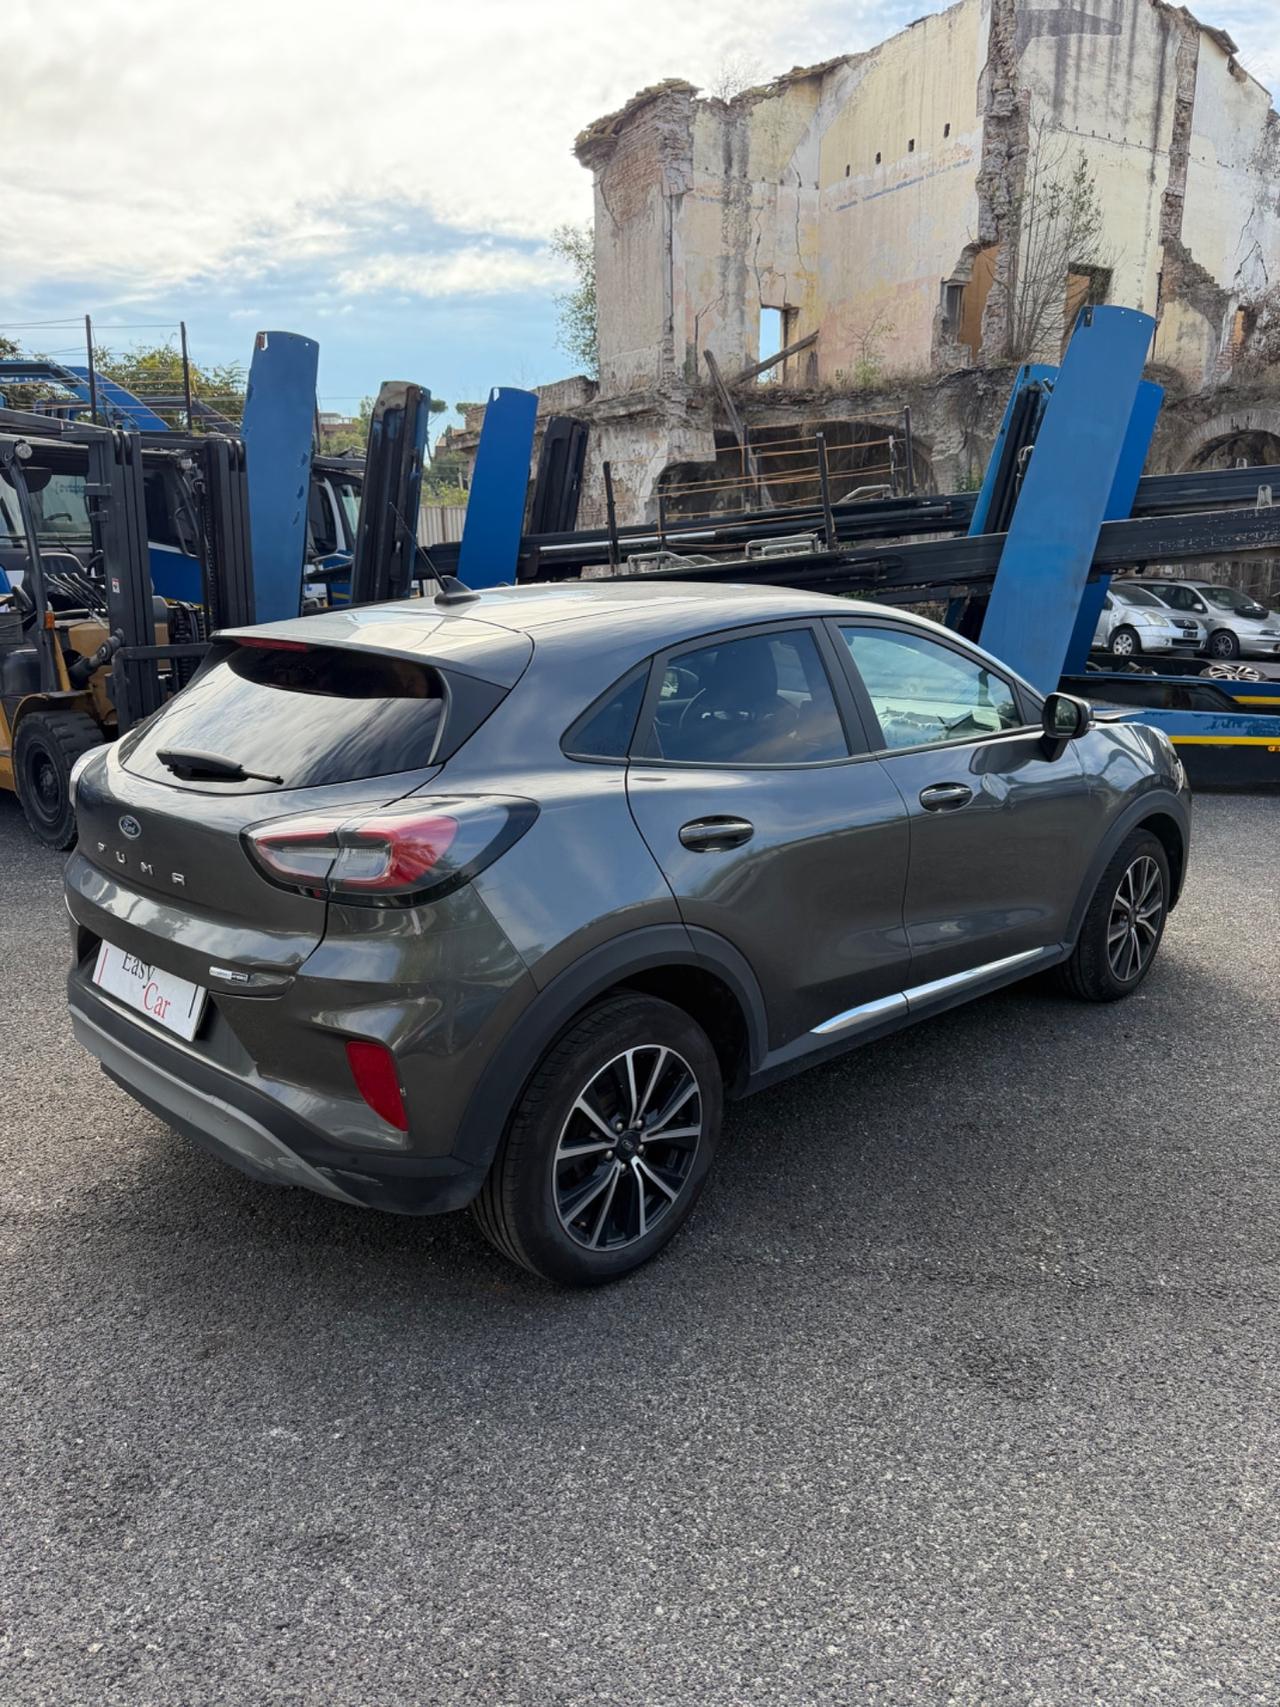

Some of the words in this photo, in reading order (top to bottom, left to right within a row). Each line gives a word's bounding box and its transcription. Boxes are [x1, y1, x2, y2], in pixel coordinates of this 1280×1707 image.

[98, 842, 185, 886] PUMA
[122, 952, 156, 989] Easy
[144, 982, 171, 1019] Car
